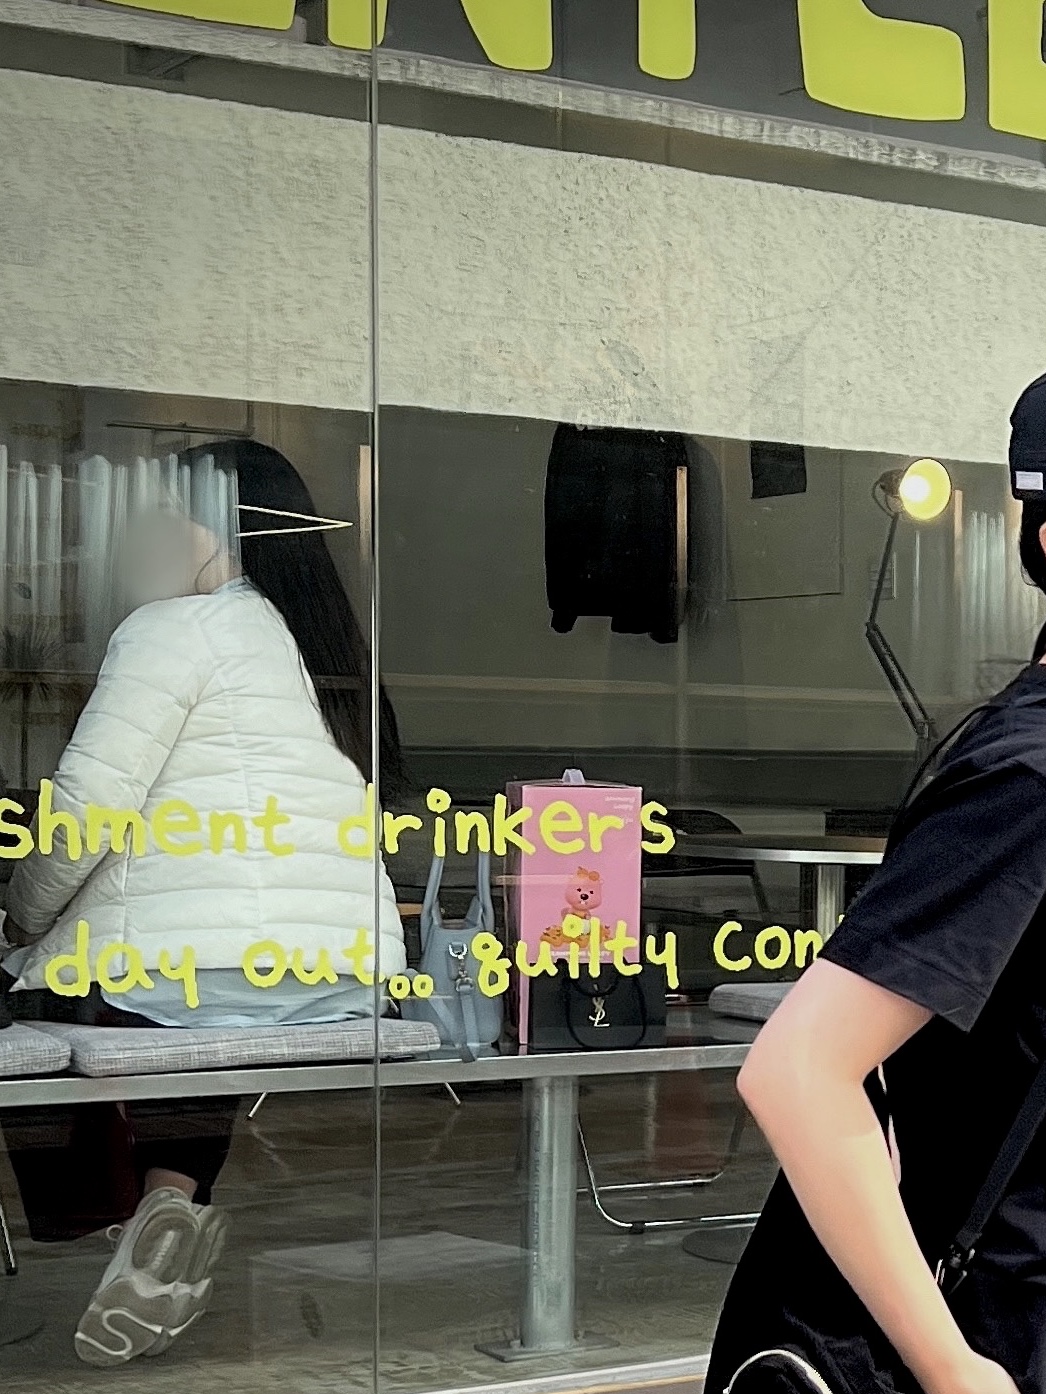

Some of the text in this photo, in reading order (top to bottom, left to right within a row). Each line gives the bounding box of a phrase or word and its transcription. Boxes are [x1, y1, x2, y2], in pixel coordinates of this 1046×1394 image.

[337, 782, 676, 858] drinkers
[44, 919, 200, 1009] day
[470, 914, 680, 998] guilty
